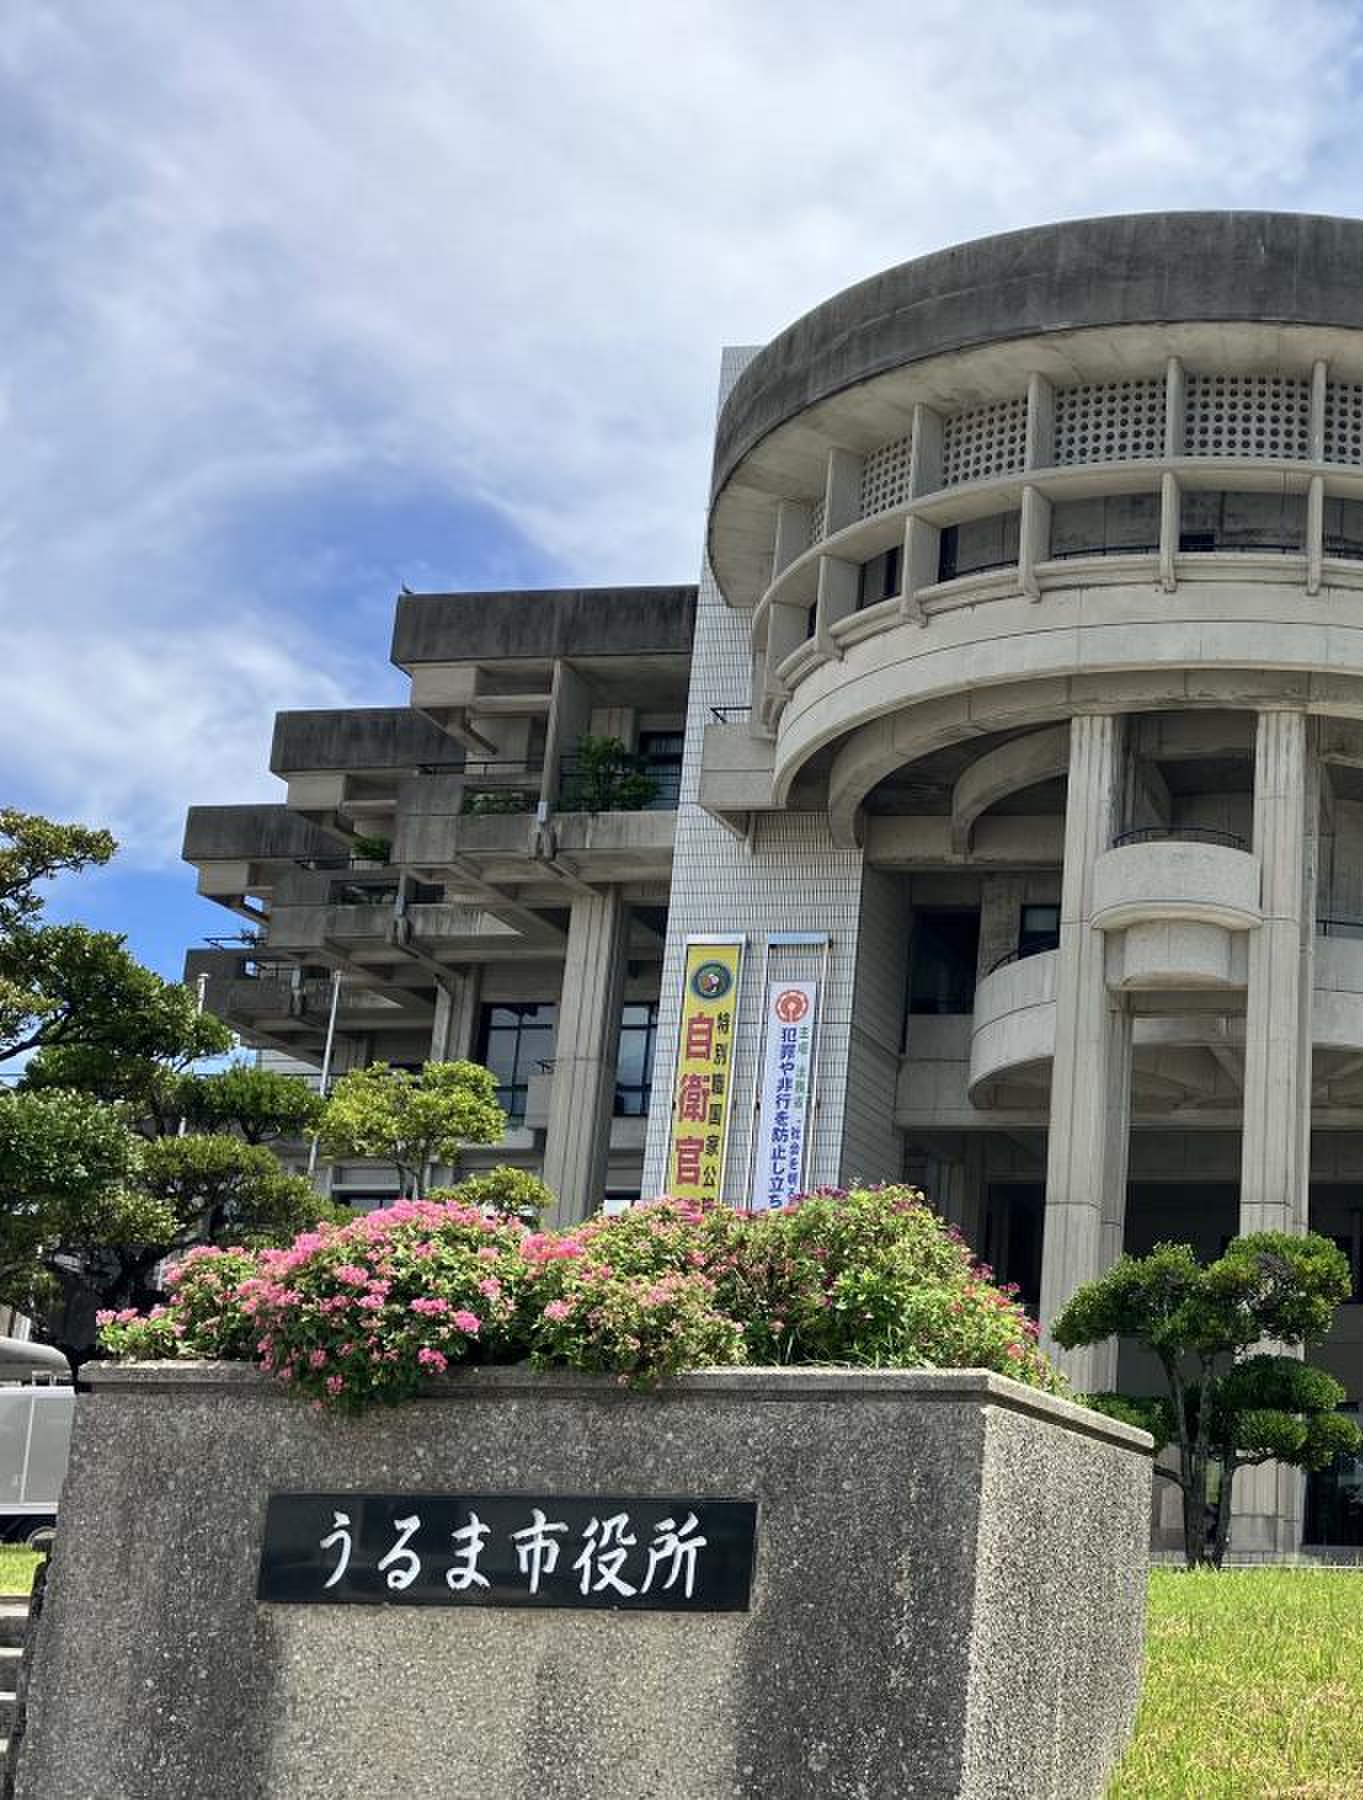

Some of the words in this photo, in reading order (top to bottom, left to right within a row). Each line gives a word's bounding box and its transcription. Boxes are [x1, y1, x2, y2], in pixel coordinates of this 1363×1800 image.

[319, 1507, 708, 1599] うるま市役所
